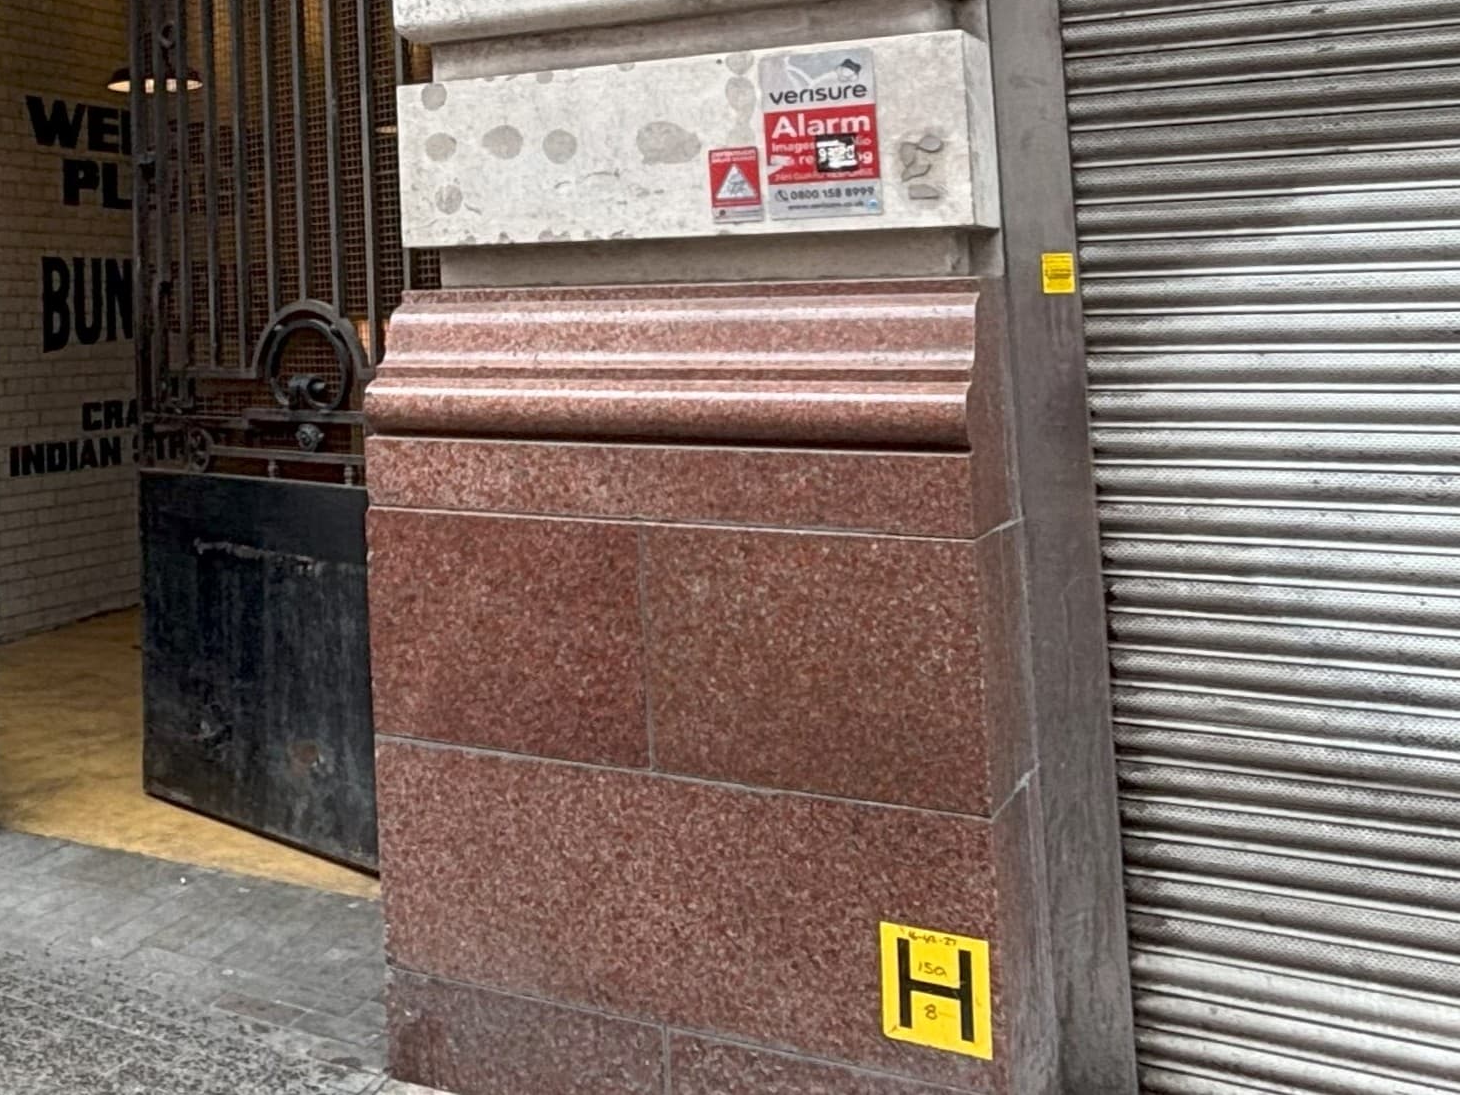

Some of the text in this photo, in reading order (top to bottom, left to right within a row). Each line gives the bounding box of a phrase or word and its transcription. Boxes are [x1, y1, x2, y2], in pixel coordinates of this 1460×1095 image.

[769, 84, 867, 105] verisure
[771, 113, 871, 139] Alarm
[790, 189, 819, 200] 0800
[9, 436, 122, 477] INDIAN
[897, 936, 975, 1043] H
[923, 1003, 938, 1020] 8
